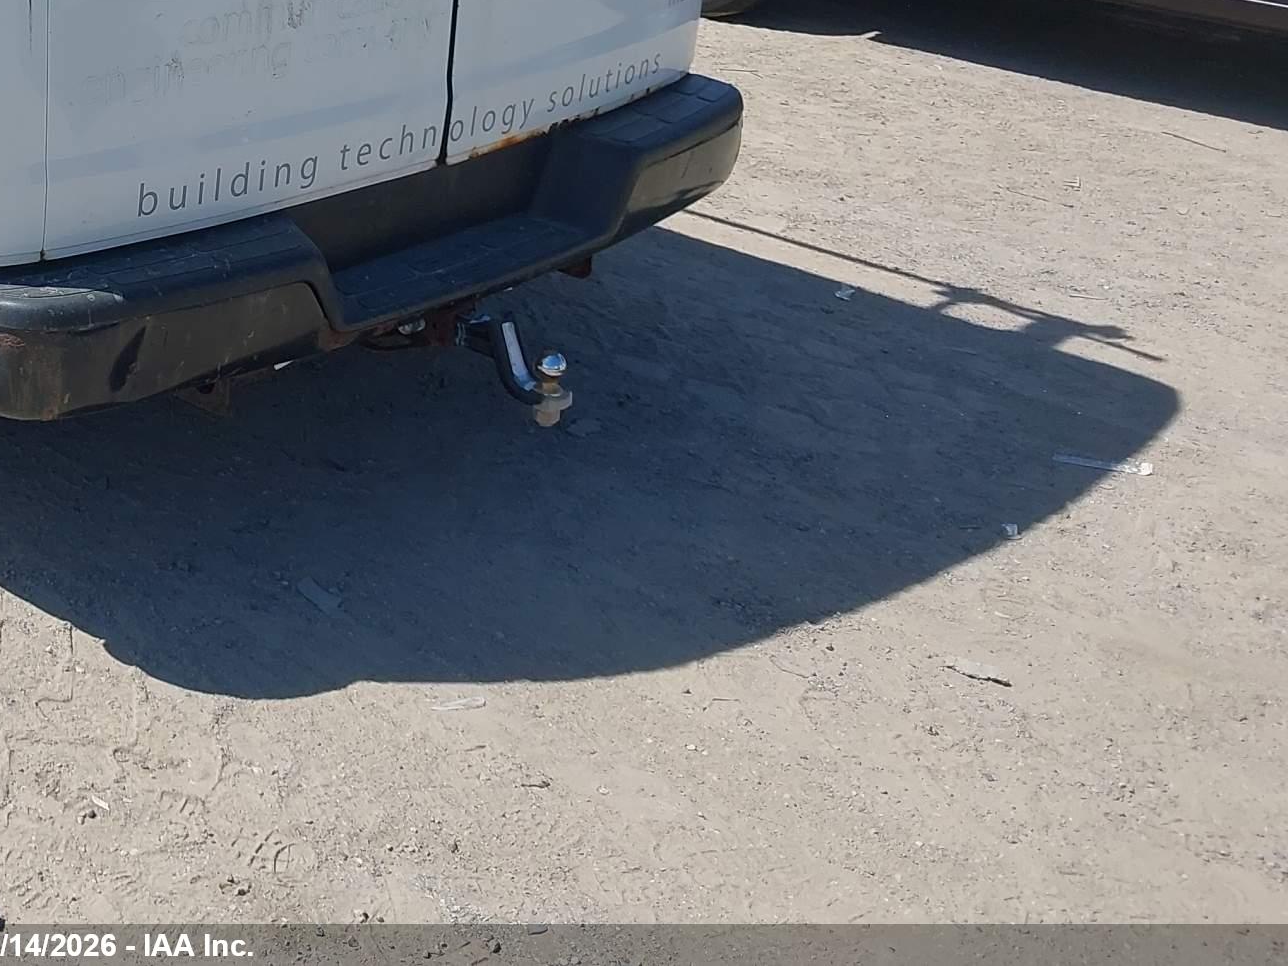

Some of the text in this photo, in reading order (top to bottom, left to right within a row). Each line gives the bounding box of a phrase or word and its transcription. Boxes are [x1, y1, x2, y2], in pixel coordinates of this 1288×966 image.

[137, 53, 661, 217] building technology solutions
